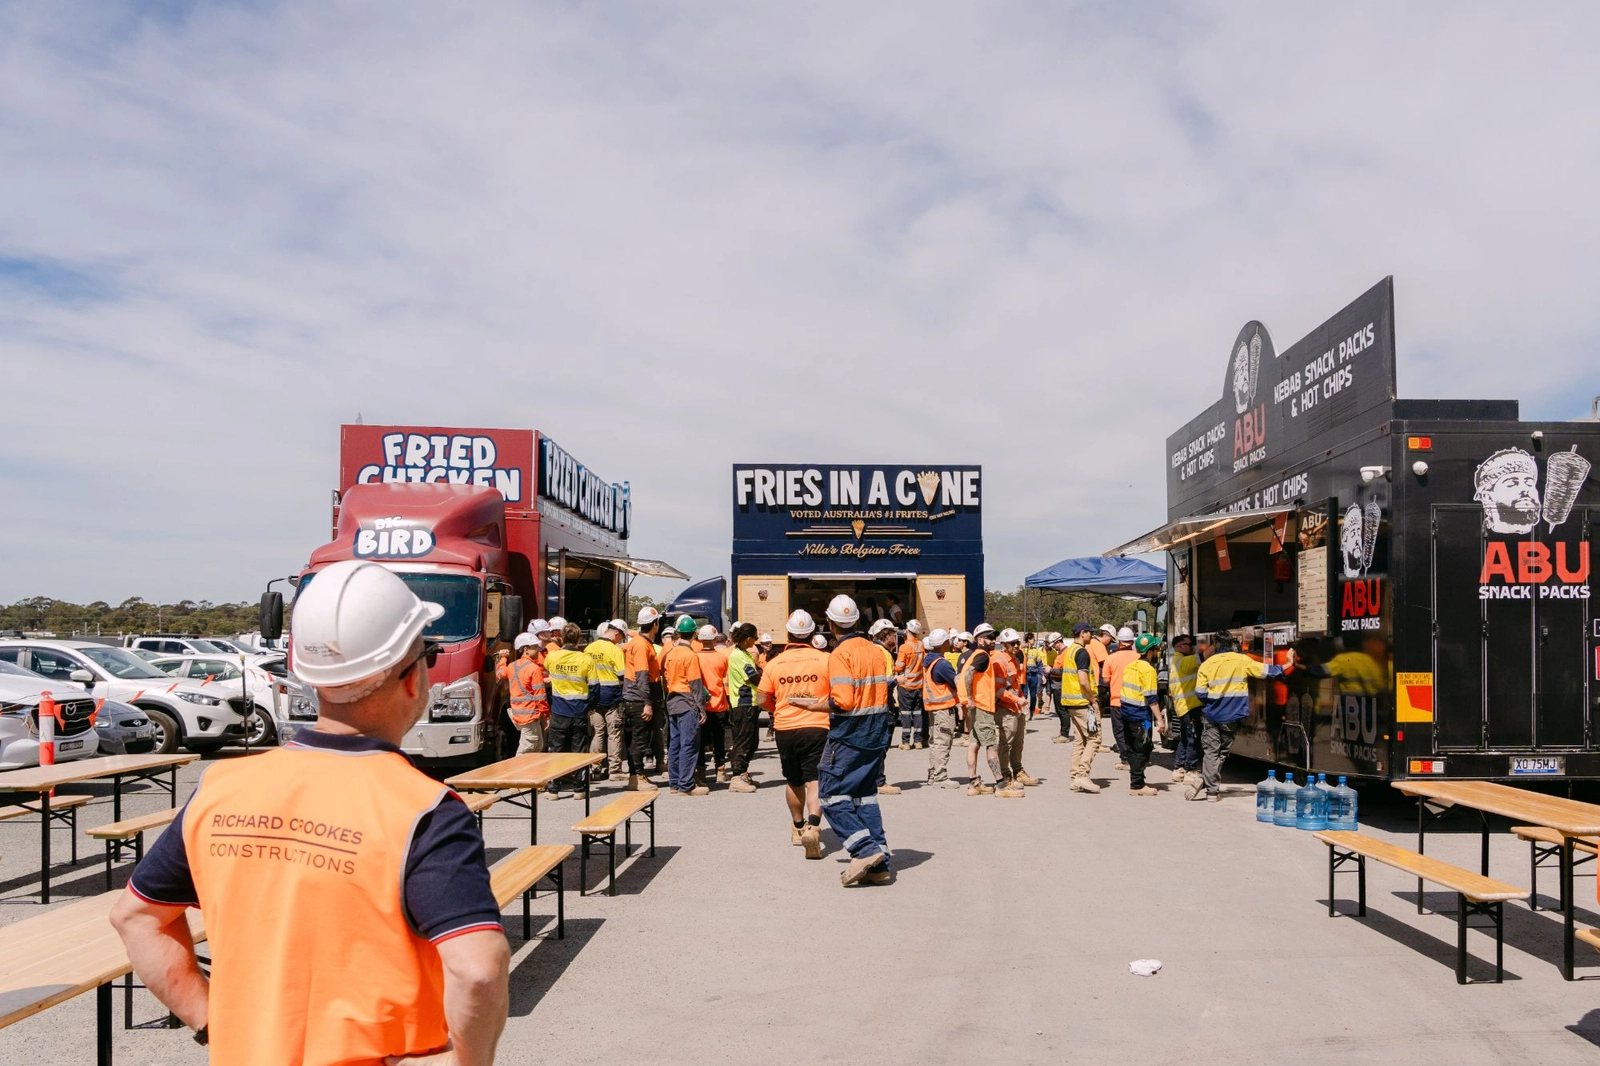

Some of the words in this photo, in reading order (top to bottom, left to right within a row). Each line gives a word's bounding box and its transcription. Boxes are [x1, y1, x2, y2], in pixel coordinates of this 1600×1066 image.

[1274, 372, 1302, 404] KEBAB
[1304, 348, 1336, 384] SNACK
[1338, 322, 1374, 364] PACKS
[1291, 401, 1298, 418] &
[1301, 384, 1320, 412] HOT
[1323, 365, 1353, 399] CHIPS
[1172, 446, 1188, 469] KEBAB
[1188, 434, 1206, 458] SNACK
[1206, 421, 1226, 447] PACKS
[1233, 403, 1266, 459] ABU
[383, 433, 496, 468] FRIED
[1181, 466, 1186, 480] &
[1186, 459, 1197, 478] HOT
[1198, 448, 1215, 471] CHIPS
[1233, 454, 1249, 474] SNACK
[1250, 446, 1266, 465] PACKS
[736, 468, 823, 507] FRIES
[829, 470, 860, 506] IN
[868, 470, 890, 506] A
[1263, 484, 1280, 508] HOT
[1282, 472, 1308, 500] CHIPS
[375, 516, 402, 530] BIG
[790, 510, 822, 519] VOTED
[823, 510, 882, 519] AUSTRALIA'S
[884, 510, 894, 519] #1
[896, 510, 928, 519] FRITES
[1302, 512, 1322, 530] ABU
[357, 529, 433, 555] BIRD
[798, 544, 838, 556] Nilla's
[840, 544, 887, 558] Belgian
[889, 544, 921, 556] Fries
[1479, 541, 1590, 583] ABU
[1342, 577, 1381, 618] ABU
[1478, 586, 1531, 599] SNACK
[1539, 586, 1591, 599] PACKS
[1341, 618, 1360, 631] SNACK
[1361, 617, 1381, 630] PACKS
[556, 664, 578, 672] DELTEC
[1331, 694, 1376, 744] ABU
[1330, 741, 1352, 757] SNACK
[1354, 745, 1376, 762] PACKS
[212, 814, 283, 830] RICHARD
